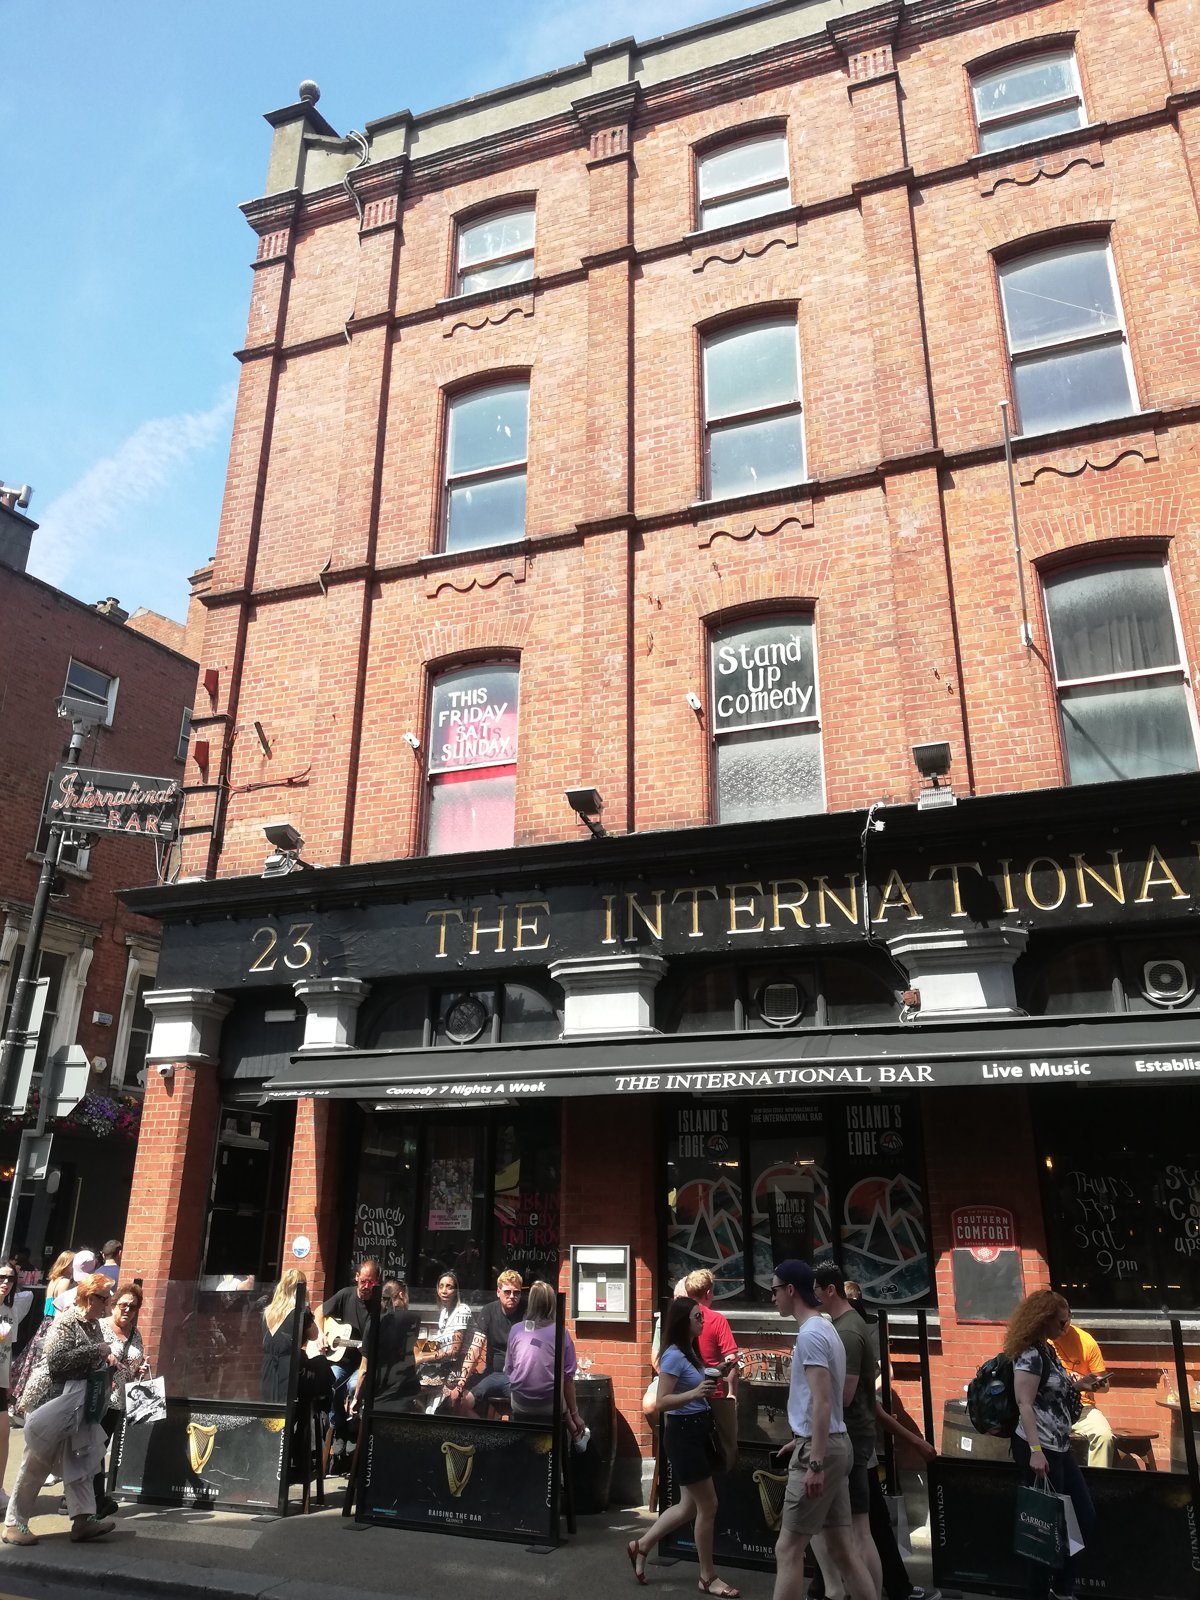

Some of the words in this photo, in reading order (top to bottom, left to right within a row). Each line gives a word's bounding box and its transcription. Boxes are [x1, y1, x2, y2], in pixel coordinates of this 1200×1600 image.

[718, 634, 801, 675] Stand
[448, 687, 487, 707] THIS
[438, 702, 508, 728] FRIDAY
[456, 720, 490, 742] SAT
[441, 736, 510, 761] SUNDAY
[51, 771, 177, 810] International
[108, 810, 158, 834] BAR
[249, 923, 314, 973] 23
[426, 901, 551, 958] THE
[601, 840, 1200, 944] INTERNATIONA
[615, 1076, 660, 1091] THE
[665, 1067, 872, 1089] INTERNATIONAL
[878, 1065, 935, 1083] BAR
[982, 1064, 1023, 1079] Live
[1030, 1060, 1091, 1077] Music
[386, 1086, 437, 1095] Comedy
[439, 1086, 449, 1094] 7
[450, 1085, 492, 1096] Nights
[494, 1084, 505, 1093] A
[509, 1082, 546, 1093] Week
[678, 1108, 729, 1132] ISLAND'S
[763, 1112, 809, 1122] INTERNATIONAL
[846, 1104, 902, 1129] ISLAND'S
[679, 1134, 705, 1157] EDGE
[848, 1131, 878, 1156] EDGE
[358, 1203, 405, 1226] Comedy
[957, 1215, 1008, 1225] SOUTHERN
[363, 1218, 394, 1236] Club
[957, 1225, 1010, 1240] COMFORT
[1074, 1223, 1125, 1251] Sat
[357, 1235, 397, 1251] upstairs
[428, 1509, 454, 1519] RAISING
[456, 1512, 467, 1520] THE
[469, 1514, 482, 1522] BAR
[742, 1543, 773, 1554] RAISING
